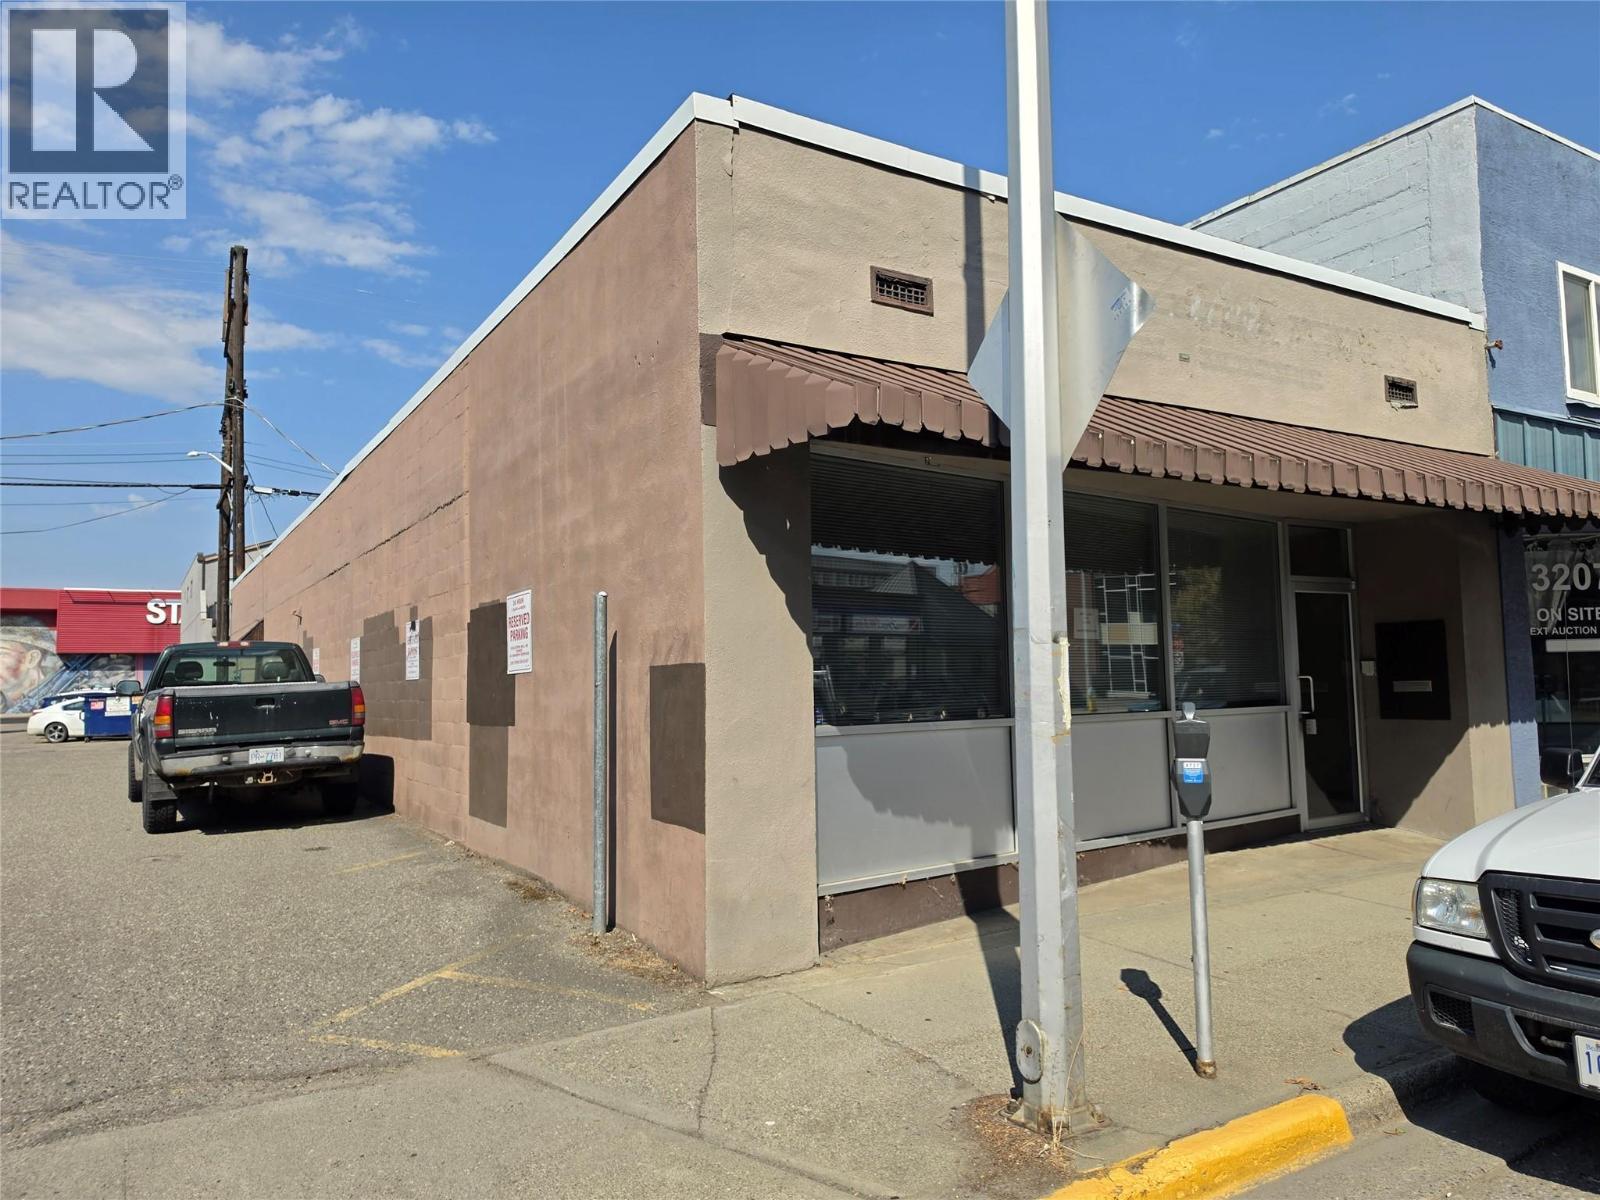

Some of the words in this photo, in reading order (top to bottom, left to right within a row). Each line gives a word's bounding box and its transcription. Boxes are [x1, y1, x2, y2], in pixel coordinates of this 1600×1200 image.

[146, 599, 181, 625] ST
[1536, 608, 1562, 622] ON
[508, 612, 530, 629] RESERVED
[510, 627, 528, 641] PARKING
[1551, 626, 1597, 636] AUCTION
